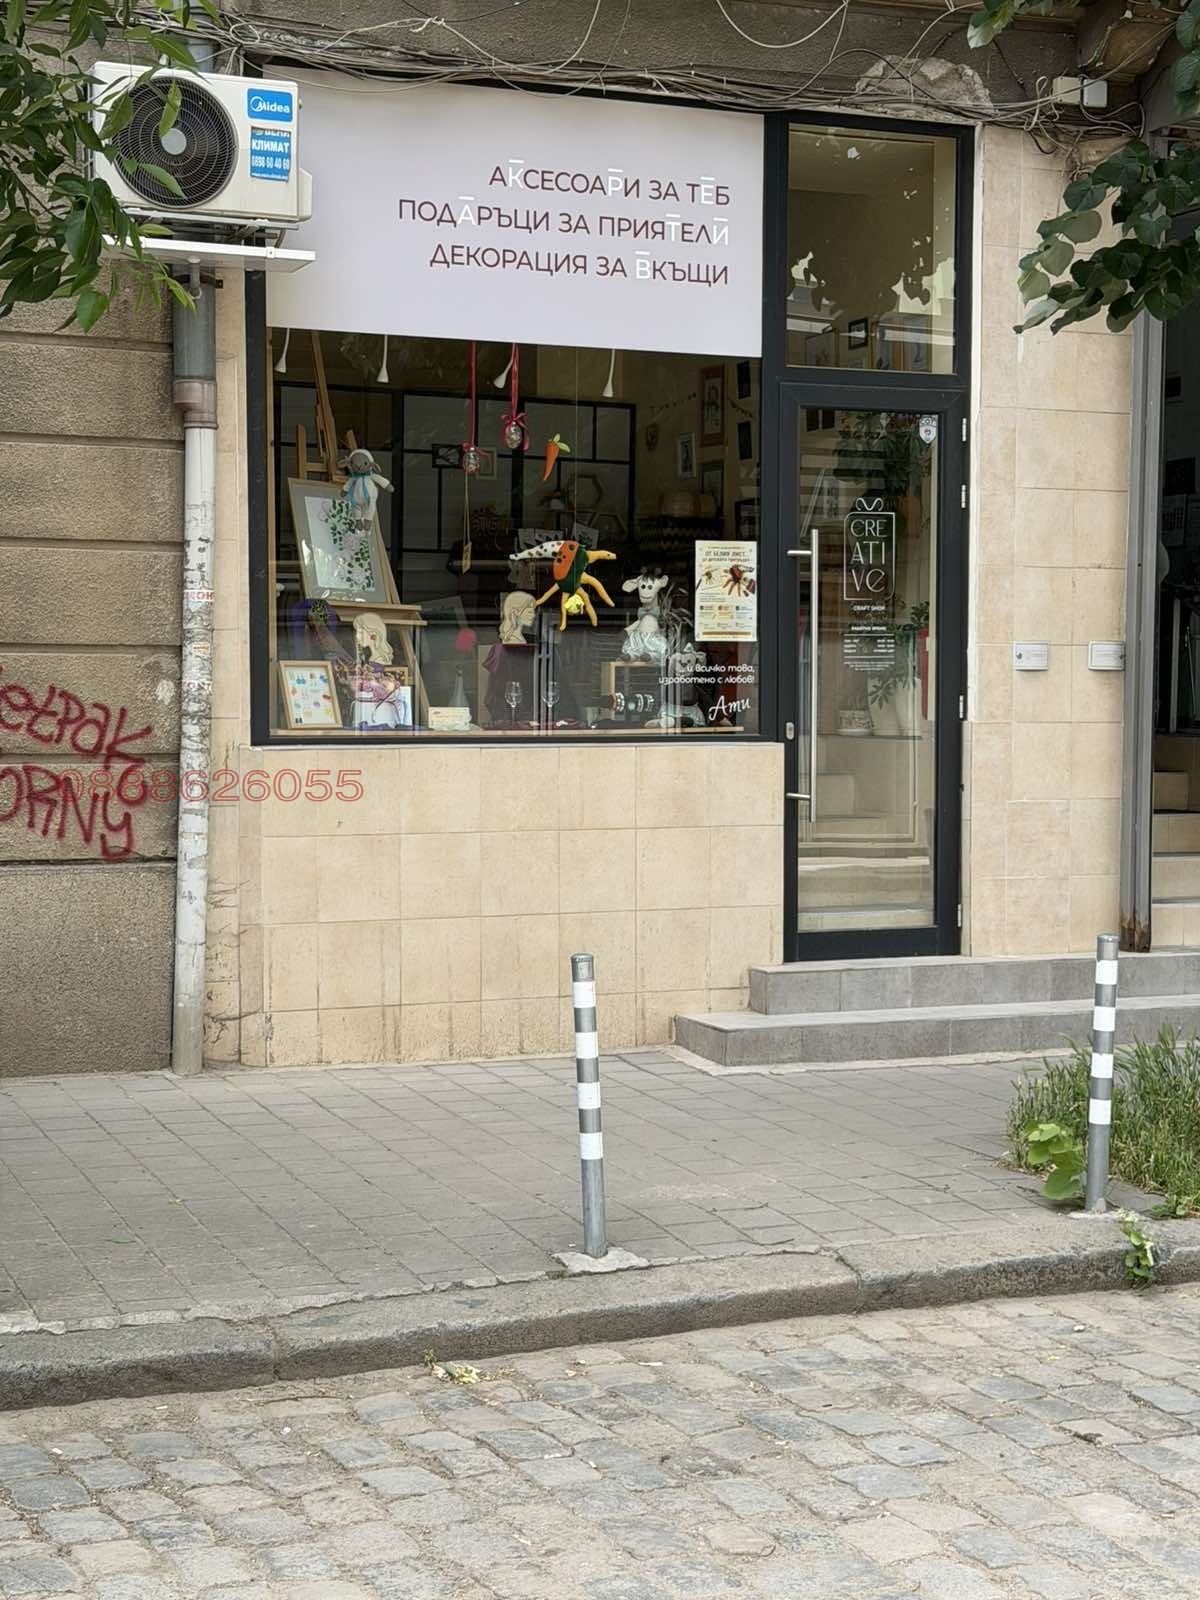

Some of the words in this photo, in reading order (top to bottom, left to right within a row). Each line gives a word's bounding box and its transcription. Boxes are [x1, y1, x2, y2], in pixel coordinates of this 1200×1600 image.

[250, 96, 291, 113] Midea
[251, 139, 290, 153] КЛИМАТ
[489, 162, 640, 198] АКСЕСОАРИ
[648, 180, 679, 202] ЗА
[687, 180, 730, 206] ТЕБ
[399, 198, 550, 234] ПОДАРЪЦИ
[558, 213, 590, 235] ЗА
[599, 215, 729, 246] ПРИЯТЕЛИ
[430, 244, 587, 277] ДЕКОРАЦИЯ
[596, 257, 627, 278] ЗА
[635, 255, 728, 287] ВКЪЩИ
[695, 664, 726, 673] всичко
[658, 674, 715, 685] изработено
[724, 674, 755, 684] любов!
[708, 695, 752, 721] Ати
